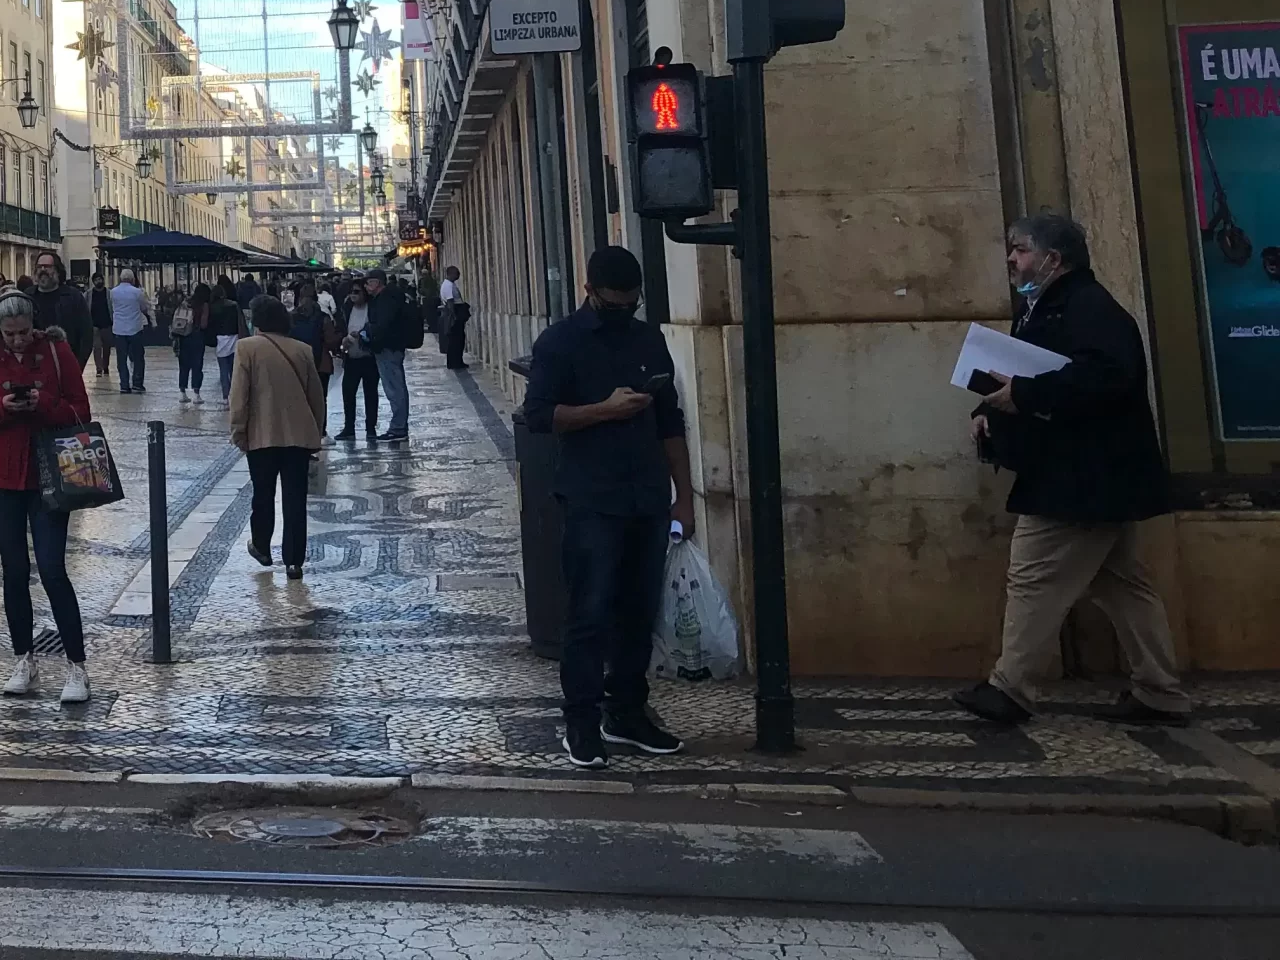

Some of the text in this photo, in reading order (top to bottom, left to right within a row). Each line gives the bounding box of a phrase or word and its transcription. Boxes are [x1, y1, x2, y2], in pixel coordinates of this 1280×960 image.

[513, 11, 557, 25] EXCEPTO
[494, 25, 578, 41] LIMPEZA URBANA
[1201, 43, 1280, 80] É UMA
[1213, 80, 1280, 118] ATRÁ
